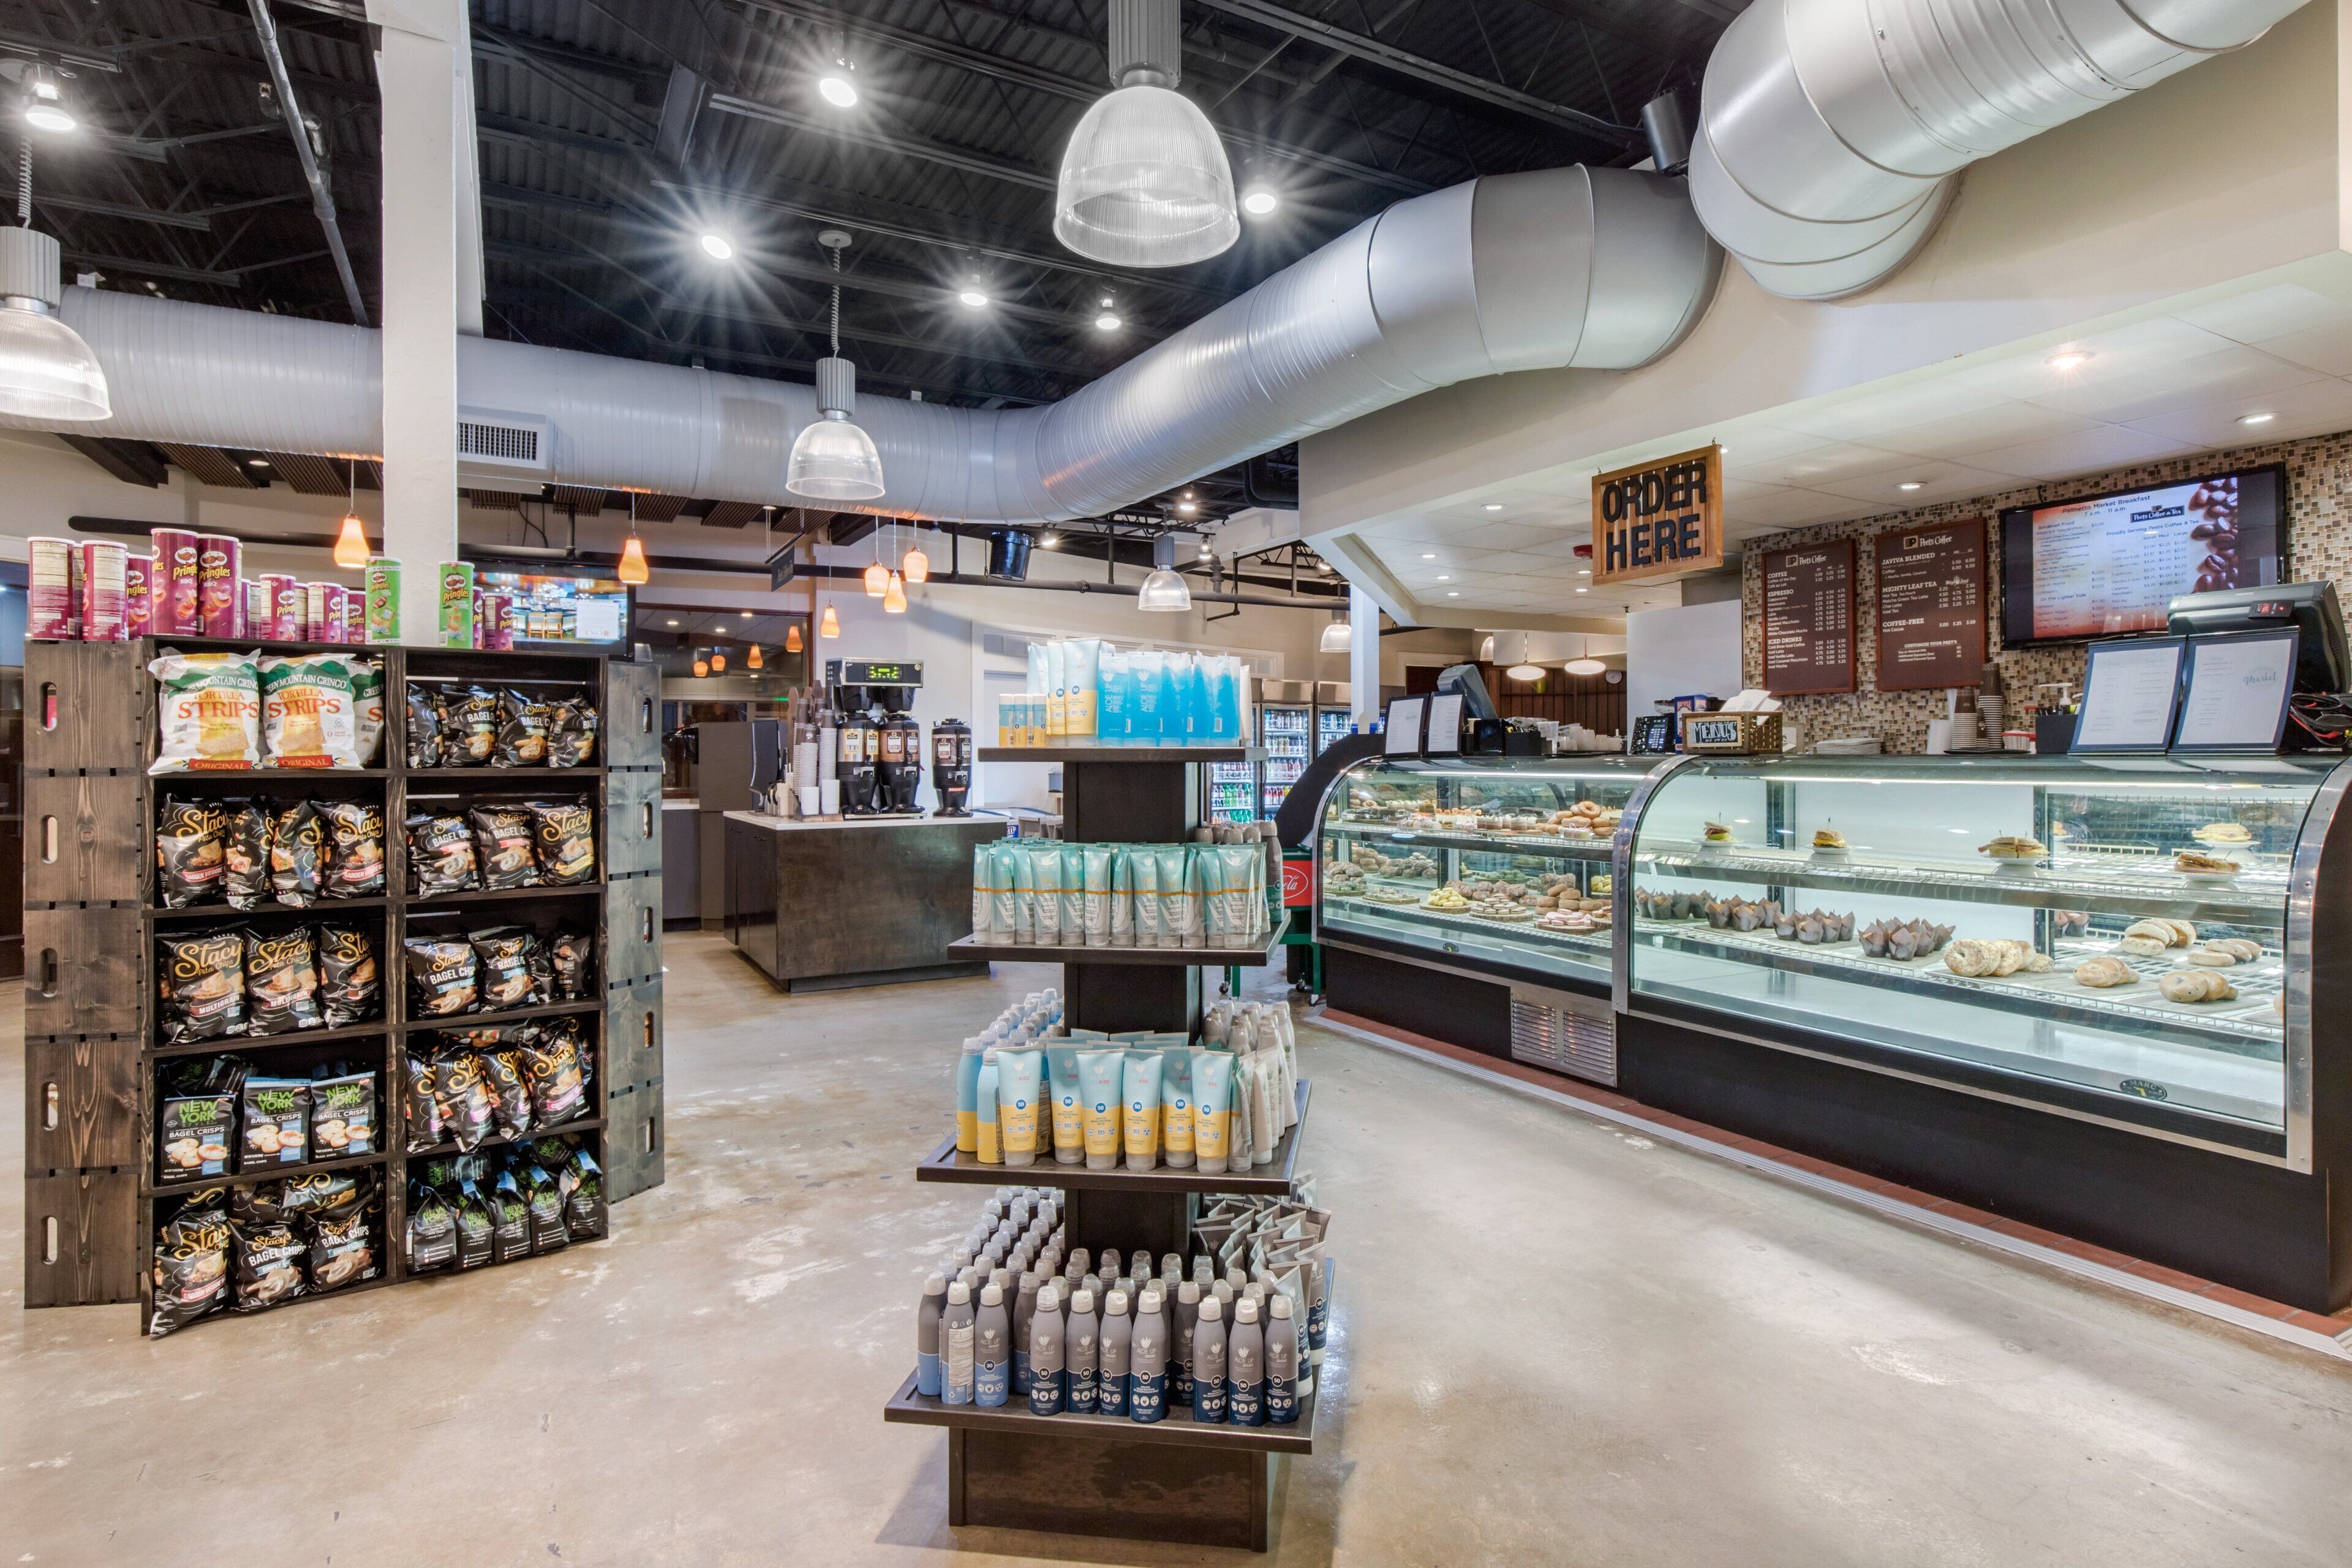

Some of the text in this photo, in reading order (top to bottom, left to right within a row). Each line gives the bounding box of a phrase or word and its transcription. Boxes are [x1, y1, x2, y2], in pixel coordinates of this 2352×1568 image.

[1603, 462, 1706, 522] ORDER
[2118, 496, 2150, 505] Breakfast
[1607, 513, 1700, 570] HERE
[1935, 535, 1952, 545] Coffee
[1812, 554, 1827, 564] Coffee
[1905, 552, 1936, 562] BLENDED
[198, 567, 231, 583] Pringles
[370, 581, 390, 592] Pringles
[442, 589, 470, 605] Pringles
[1883, 618, 1924, 627] COFFEE-FREE
[197, 676, 237, 688] MOUNTAIN
[280, 674, 347, 689] MOUNTAIN GRINGO
[1105, 683, 1112, 692] UP
[1140, 682, 1147, 691] UP
[194, 691, 245, 699] TORTILLA
[278, 688, 324, 700] TORTILLA
[178, 701, 259, 719] STRIPS
[268, 699, 341, 718] STRIPS
[1677, 700, 1692, 709] BICYCLE
[467, 712, 490, 722] BAGEL
[521, 717, 543, 726] BAGEL
[1690, 721, 1737, 744] MENUS
[494, 827, 519, 839] BAGEL
[432, 832, 459, 847] BAGEL
[205, 867, 224, 877] VEGGIE
[287, 956, 304, 965] Chips
[197, 959, 234, 976] Pita Chips
[430, 969, 458, 984] BAGEL
[199, 994, 239, 1014] MULTIGRAIN
[271, 990, 307, 1008] MULTIGRAIN
[326, 1084, 361, 1097] NEW
[2130, 1080, 2156, 1090] MARC
[258, 1089, 295, 1101] NEW
[328, 1093, 361, 1106] YORK
[179, 1099, 219, 1114] NEW
[258, 1098, 294, 1111] YORK
[179, 1110, 217, 1124] YORK
[423, 1206, 445, 1218] NEW
[504, 1203, 524, 1213] NEW
[424, 1212, 447, 1224] YORK
[466, 1212, 487, 1221] NEW
[467, 1219, 489, 1229] YORK
[349, 1226, 369, 1239] CHIPS
[262, 1262, 281, 1273] SIMPLY
